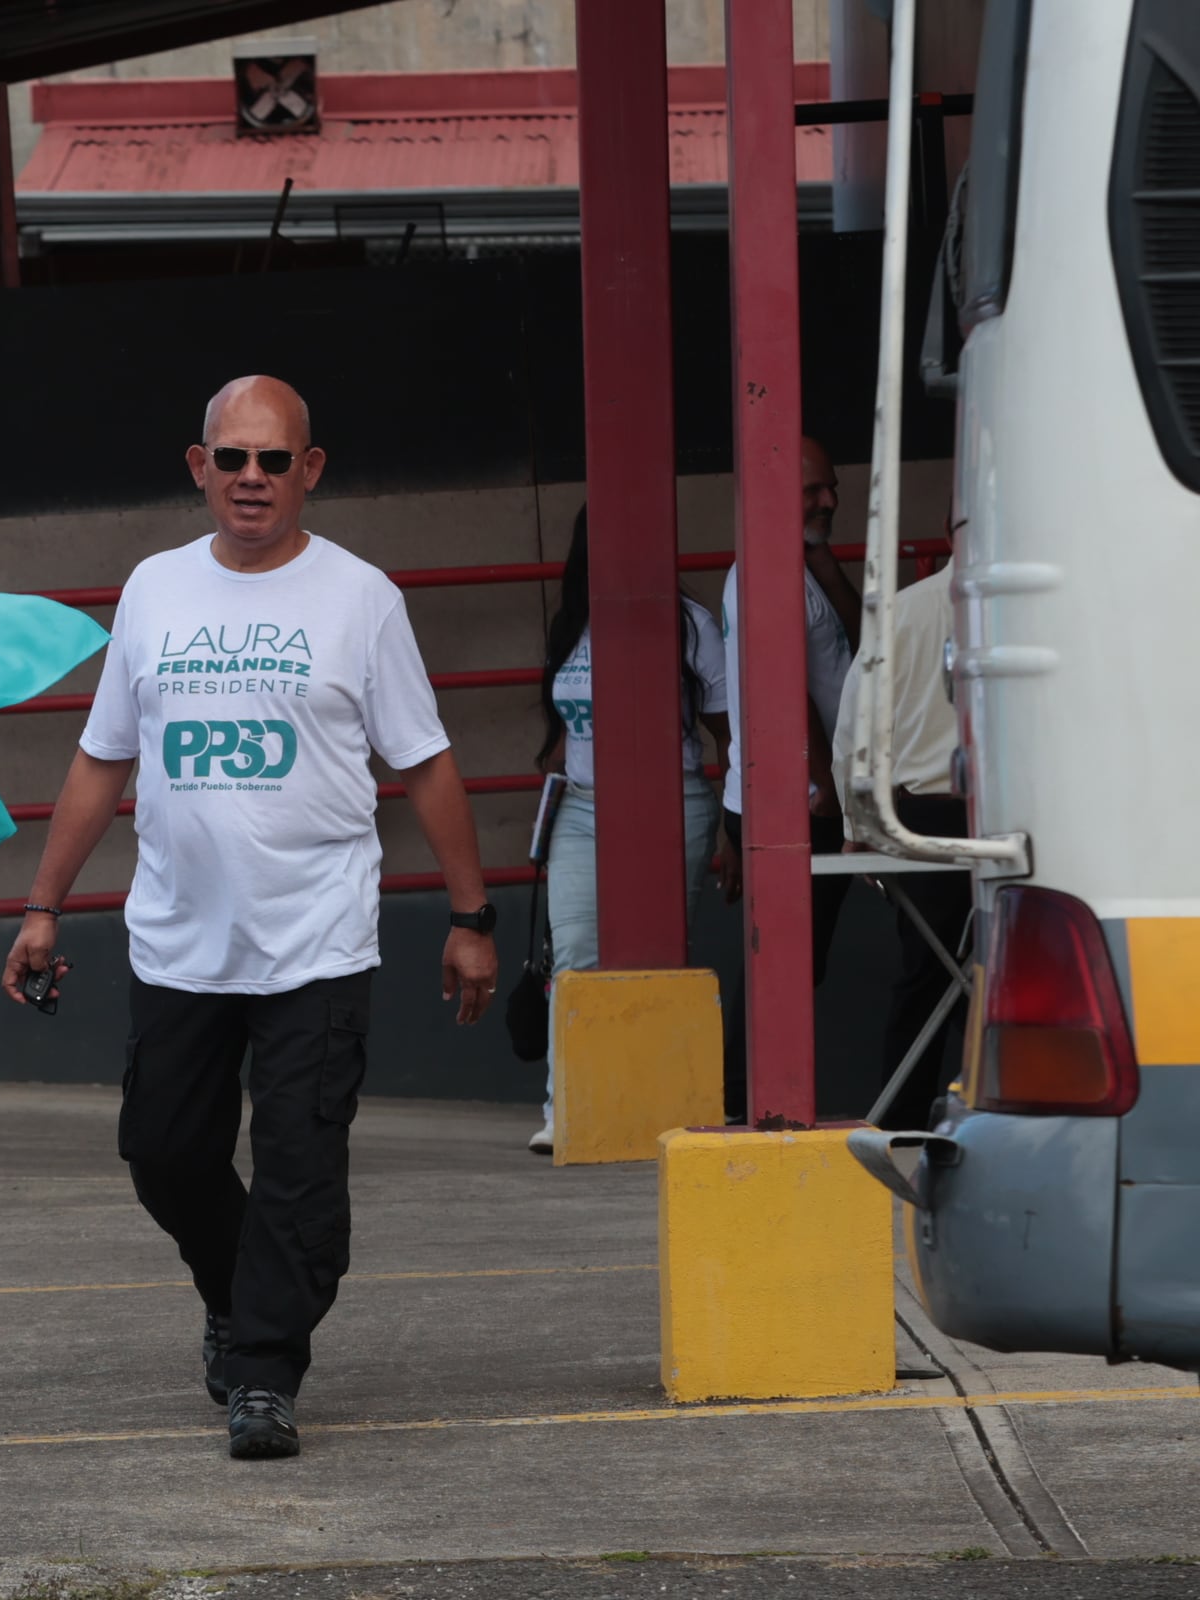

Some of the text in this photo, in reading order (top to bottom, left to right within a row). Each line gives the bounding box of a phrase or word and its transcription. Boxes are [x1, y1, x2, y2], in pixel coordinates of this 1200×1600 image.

[161, 623, 313, 660] LAURA
[156, 655, 311, 677] FERNÁNDEZ
[158, 678, 309, 698] PRESIDENTE
[170, 782, 282, 792] Partido Pueblo Soberano
